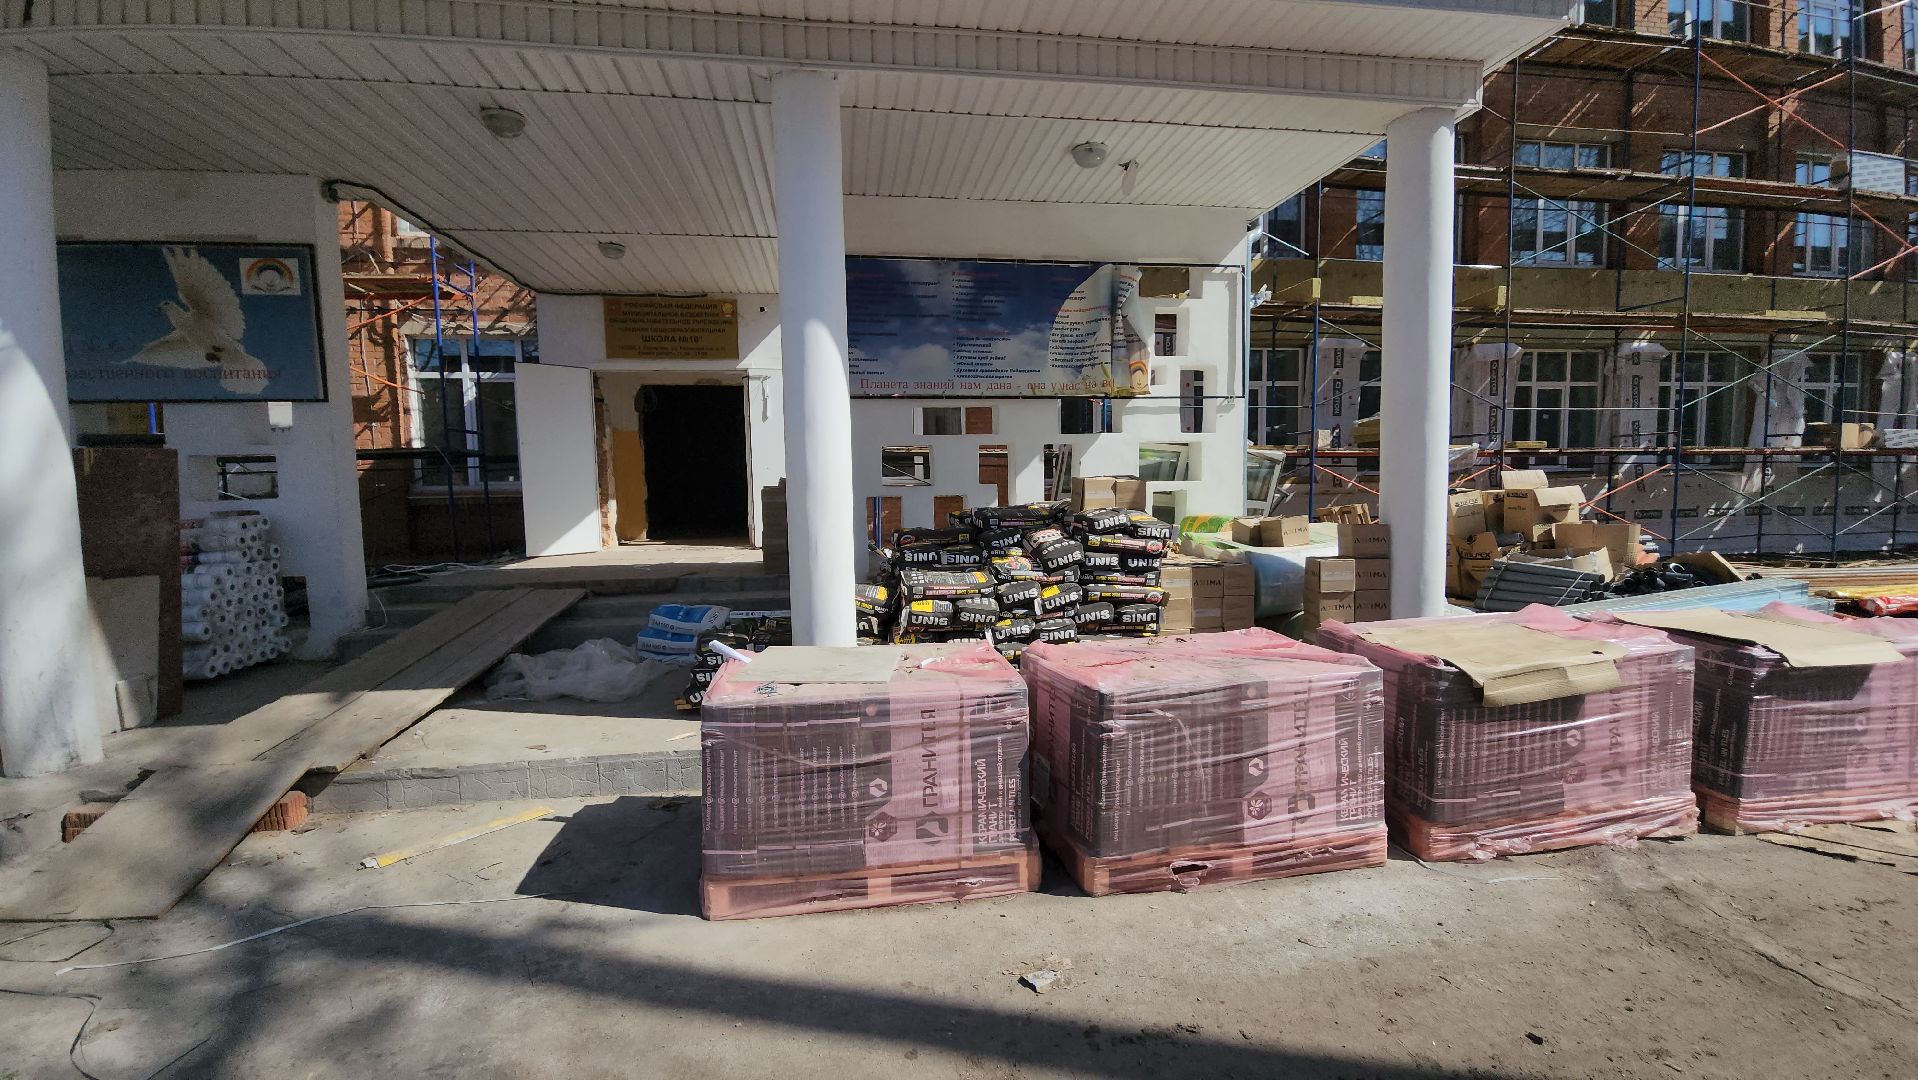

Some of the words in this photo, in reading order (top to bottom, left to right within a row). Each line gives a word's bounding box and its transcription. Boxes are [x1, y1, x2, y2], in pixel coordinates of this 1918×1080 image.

[641, 335, 676, 343] ШКОЛА
[859, 378, 909, 390] Планета
[913, 378, 955, 390] знаний
[959, 381, 981, 390] нам
[986, 382, 1012, 391] дана
[1027, 381, 1046, 390] она
[1051, 382, 1059, 392] у
[1061, 382, 1080, 391] нас
[1085, 381, 1097, 389] на
[1094, 514, 1127, 530] UNIS
[1047, 550, 1082, 569] UNIS
[1085, 556, 1119, 566] UNIS
[1127, 558, 1160, 568] UNIS
[1003, 587, 1038, 604] UNIS
[1045, 591, 1079, 610] UNIS
[911, 615, 949, 626] UNIS
[1074, 609, 1110, 624] UNIS
[995, 624, 1030, 640] UNIS
[920, 708, 938, 808] ГРАНИТЕЯ
[1338, 737, 1350, 821] КЕРАМИЧЕСКИЙ
[1008, 778, 1016, 799] TILES
[974, 758, 987, 844] КЕРАМИЧЕСКИЙ
